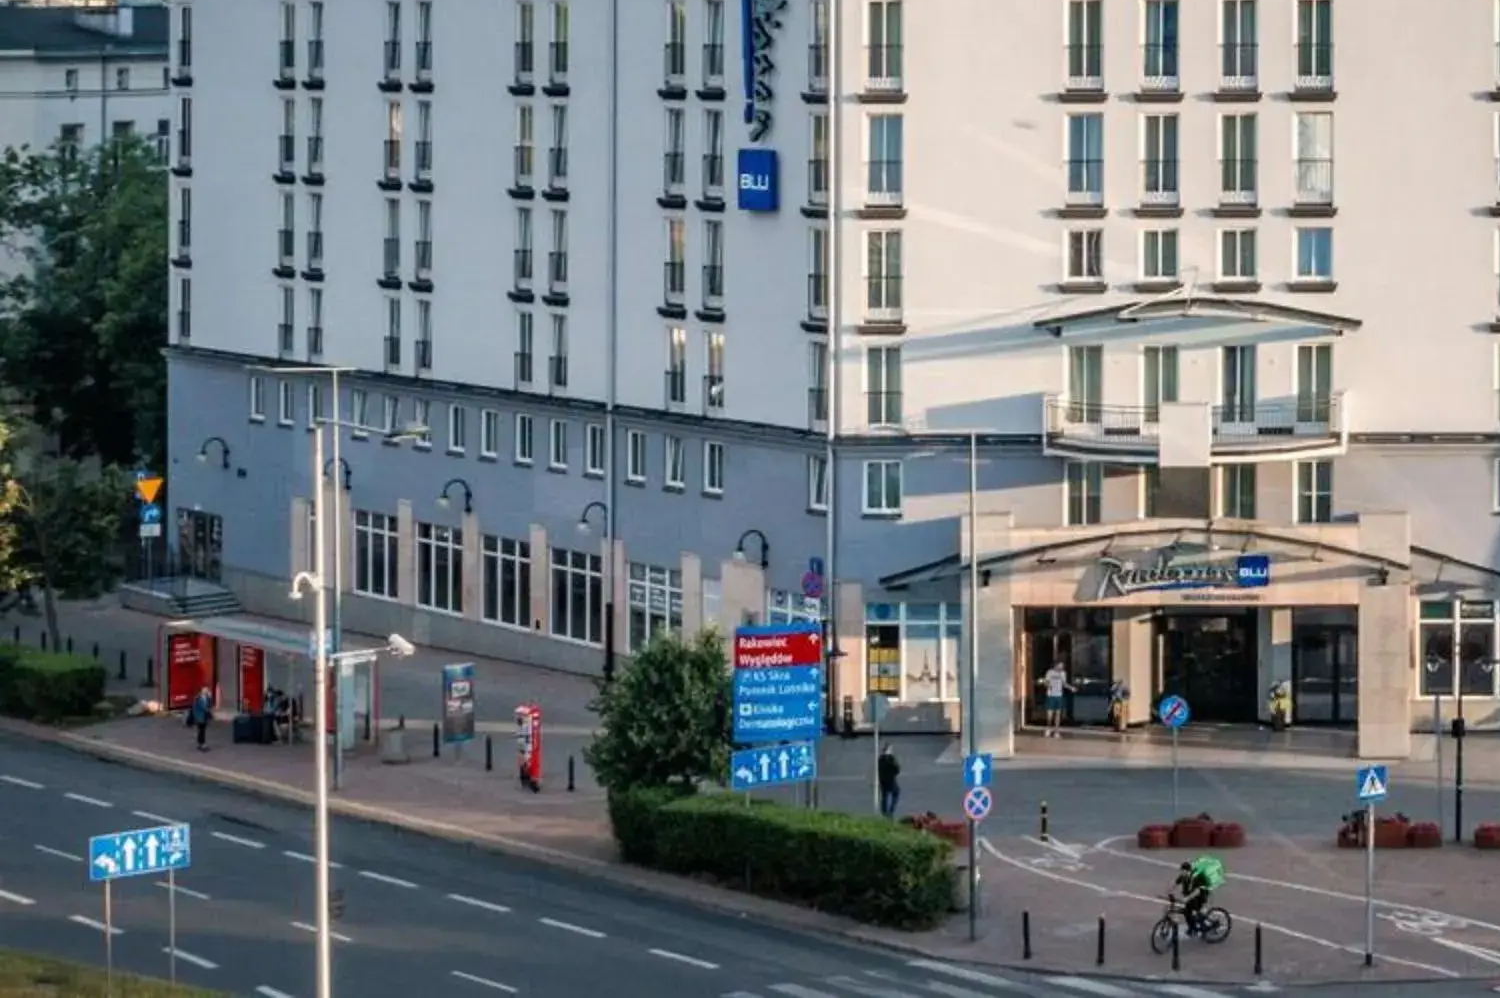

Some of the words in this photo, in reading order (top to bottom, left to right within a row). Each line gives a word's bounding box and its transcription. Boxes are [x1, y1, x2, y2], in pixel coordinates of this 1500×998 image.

[740, 172, 769, 191] BLU
[1239, 568, 1267, 578] BLU
[739, 636, 787, 649] Rakowiec
